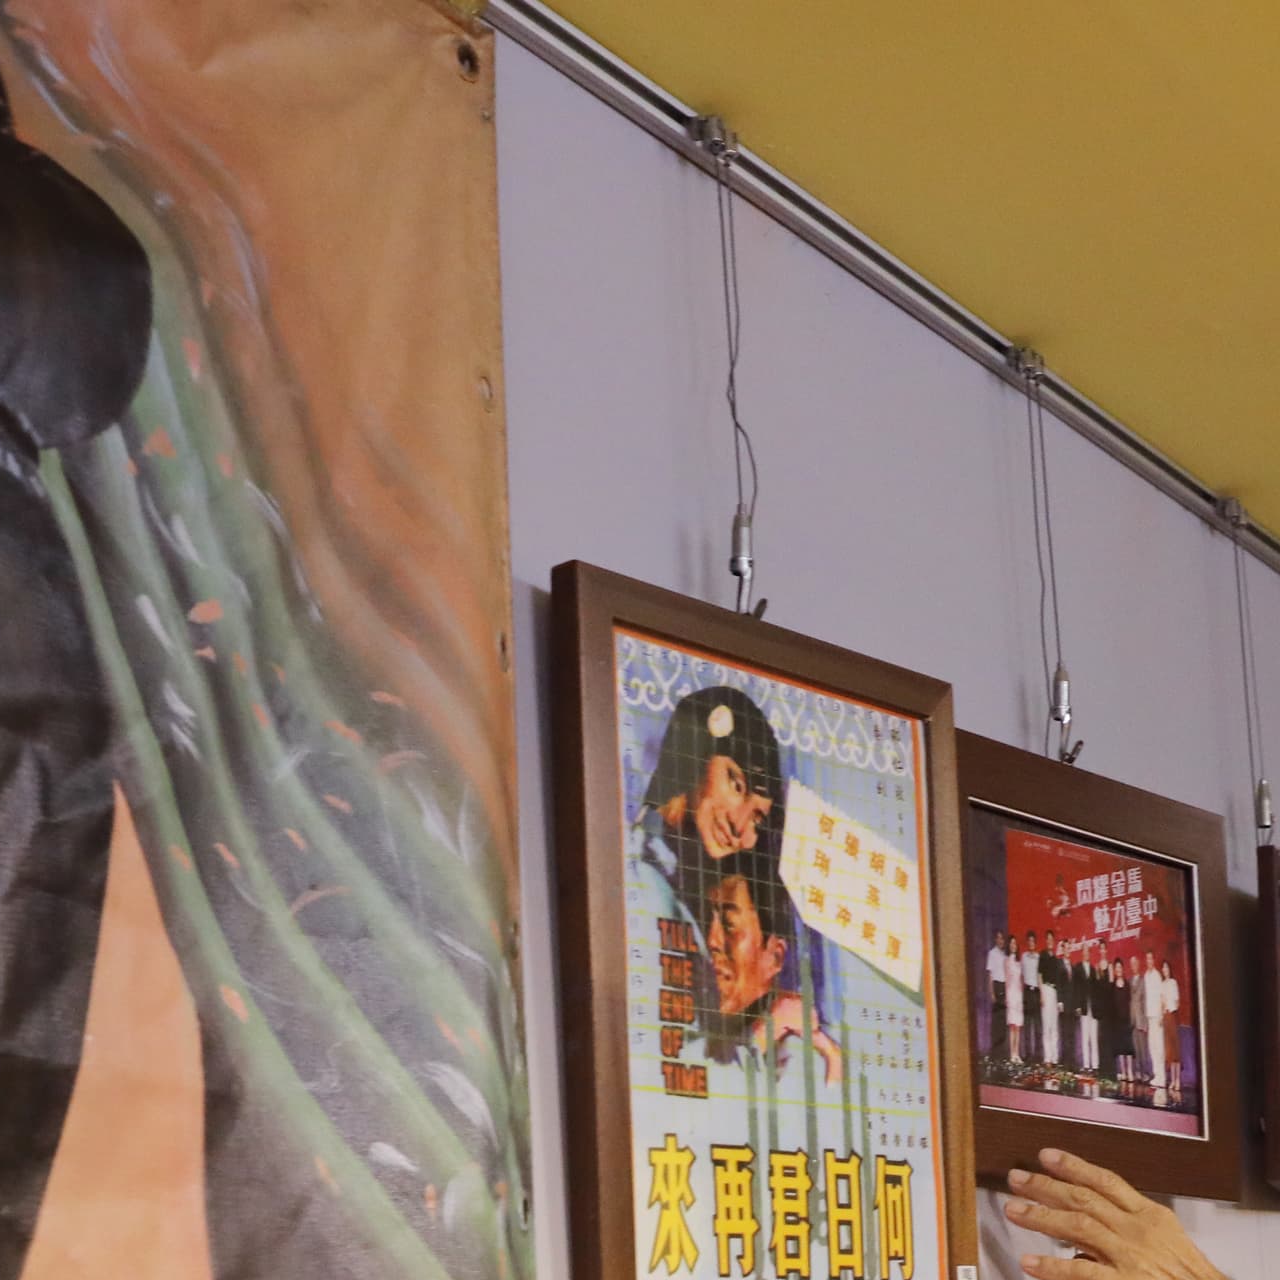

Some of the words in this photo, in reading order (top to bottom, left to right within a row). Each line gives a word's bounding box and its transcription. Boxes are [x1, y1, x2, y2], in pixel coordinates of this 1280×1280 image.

[658, 917, 700, 953] TILL
[660, 953, 694, 988] THE
[659, 988, 696, 1025] END
[661, 1025, 685, 1059] OF
[661, 1060, 709, 1099] TIME
